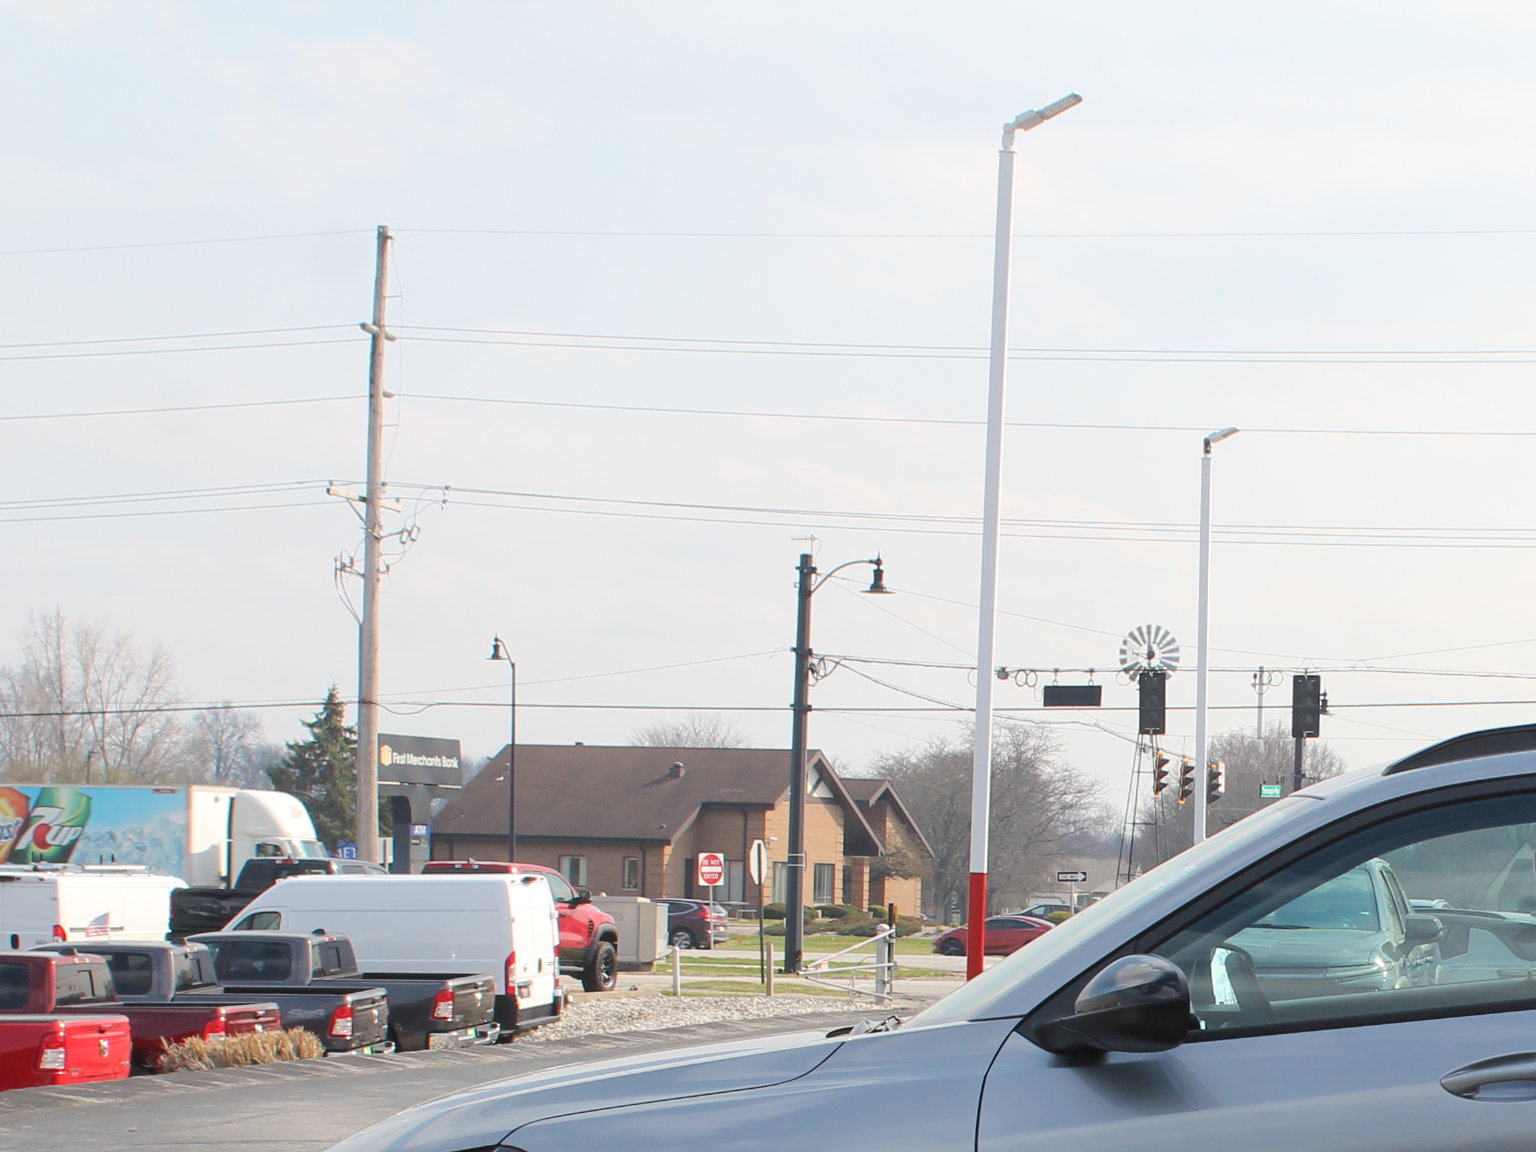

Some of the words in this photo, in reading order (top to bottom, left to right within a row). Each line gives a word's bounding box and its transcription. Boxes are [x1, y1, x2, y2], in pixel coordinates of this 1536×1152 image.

[392, 752, 406, 765] First
[406, 753, 441, 767] Merchants
[442, 755, 459, 769] Bank
[414, 825, 426, 834] ATM
